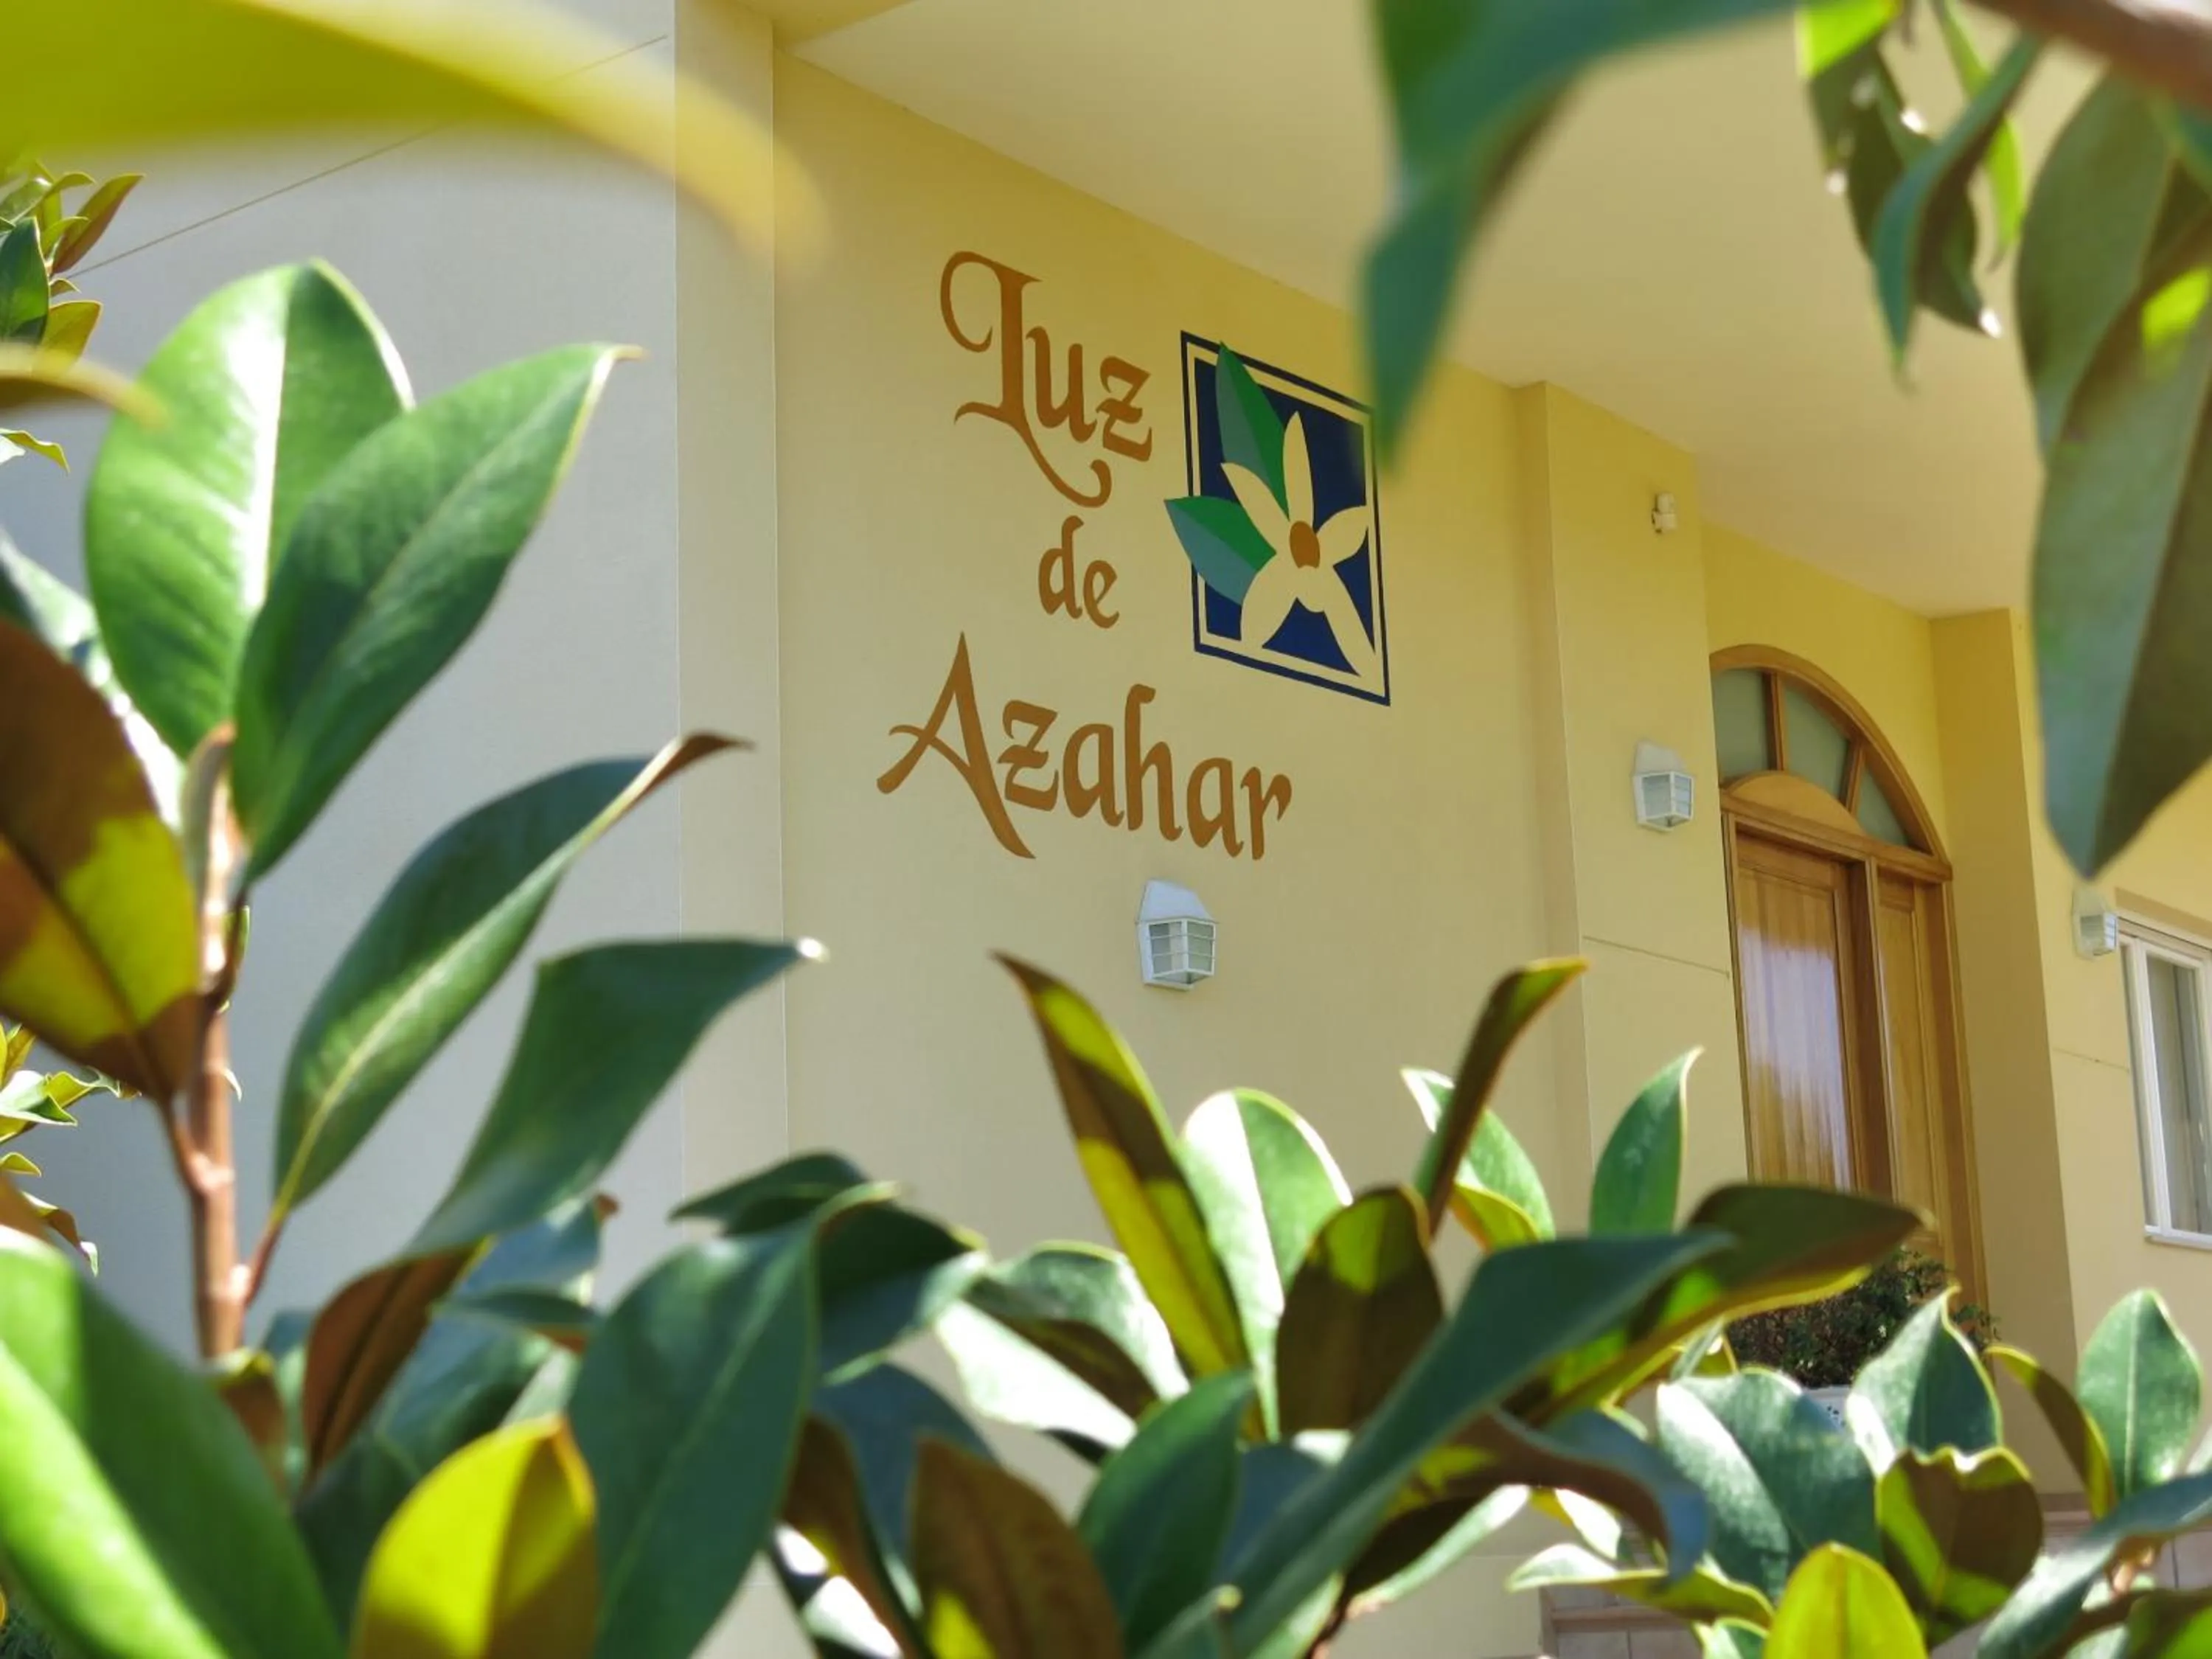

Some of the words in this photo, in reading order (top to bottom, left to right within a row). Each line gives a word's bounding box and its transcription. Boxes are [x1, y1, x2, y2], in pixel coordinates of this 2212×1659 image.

[939, 249, 1153, 509] Luz
[1037, 515, 1120, 629] de
[876, 630, 1293, 860] Azahar
